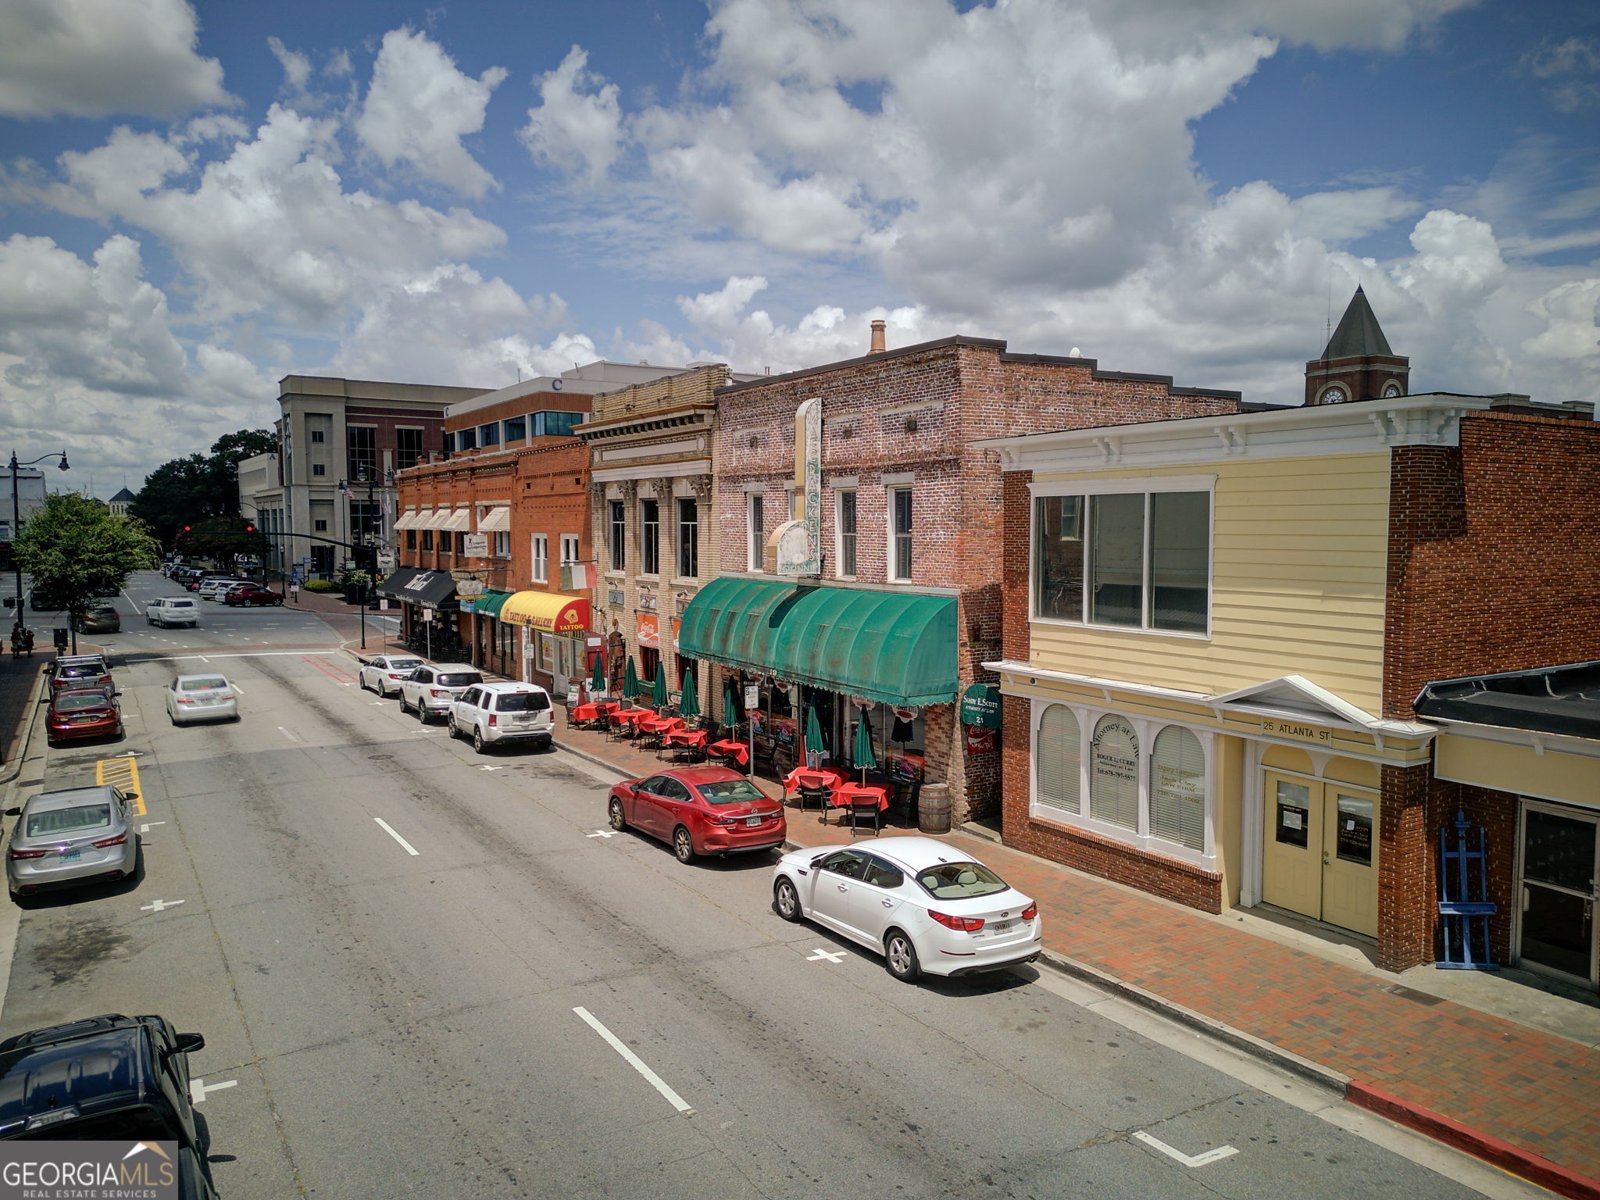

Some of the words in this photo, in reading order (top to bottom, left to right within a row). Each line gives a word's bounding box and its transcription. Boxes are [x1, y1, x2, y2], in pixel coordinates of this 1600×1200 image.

[975, 716, 984, 724] 21
[1093, 722, 1120, 751] Attorney
[1121, 727, 1130, 736] at
[1129, 734, 1140, 760] Law
[1279, 724, 1314, 738] ATLANTA
[1319, 731, 1330, 741] ST
